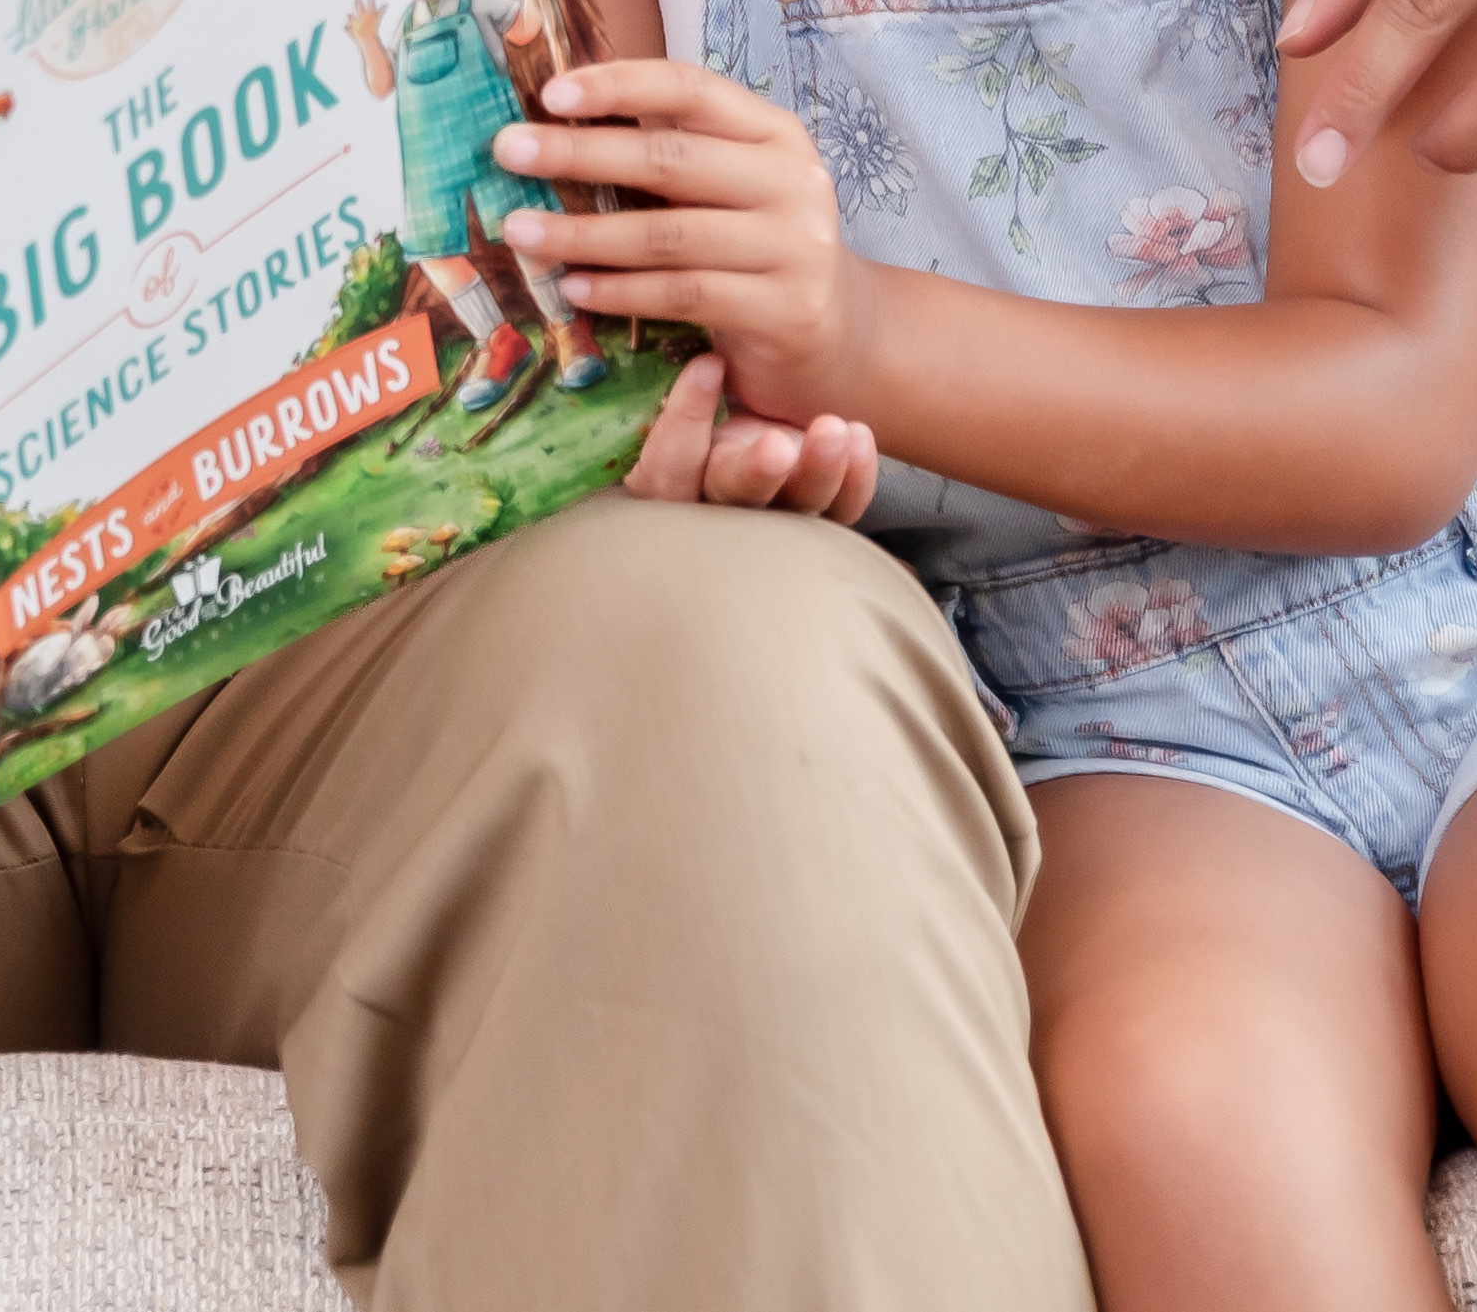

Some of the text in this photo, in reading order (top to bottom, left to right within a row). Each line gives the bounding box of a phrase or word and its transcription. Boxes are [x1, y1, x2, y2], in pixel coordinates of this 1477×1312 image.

[103, 65, 179, 155] THE
[125, 20, 339, 245] BOOK
[141, 246, 182, 303] of
[181, 195, 368, 357] STORIES
[9, 338, 412, 631] NESTS and BURROWS
[139, 529, 329, 663] Good Beautiful
